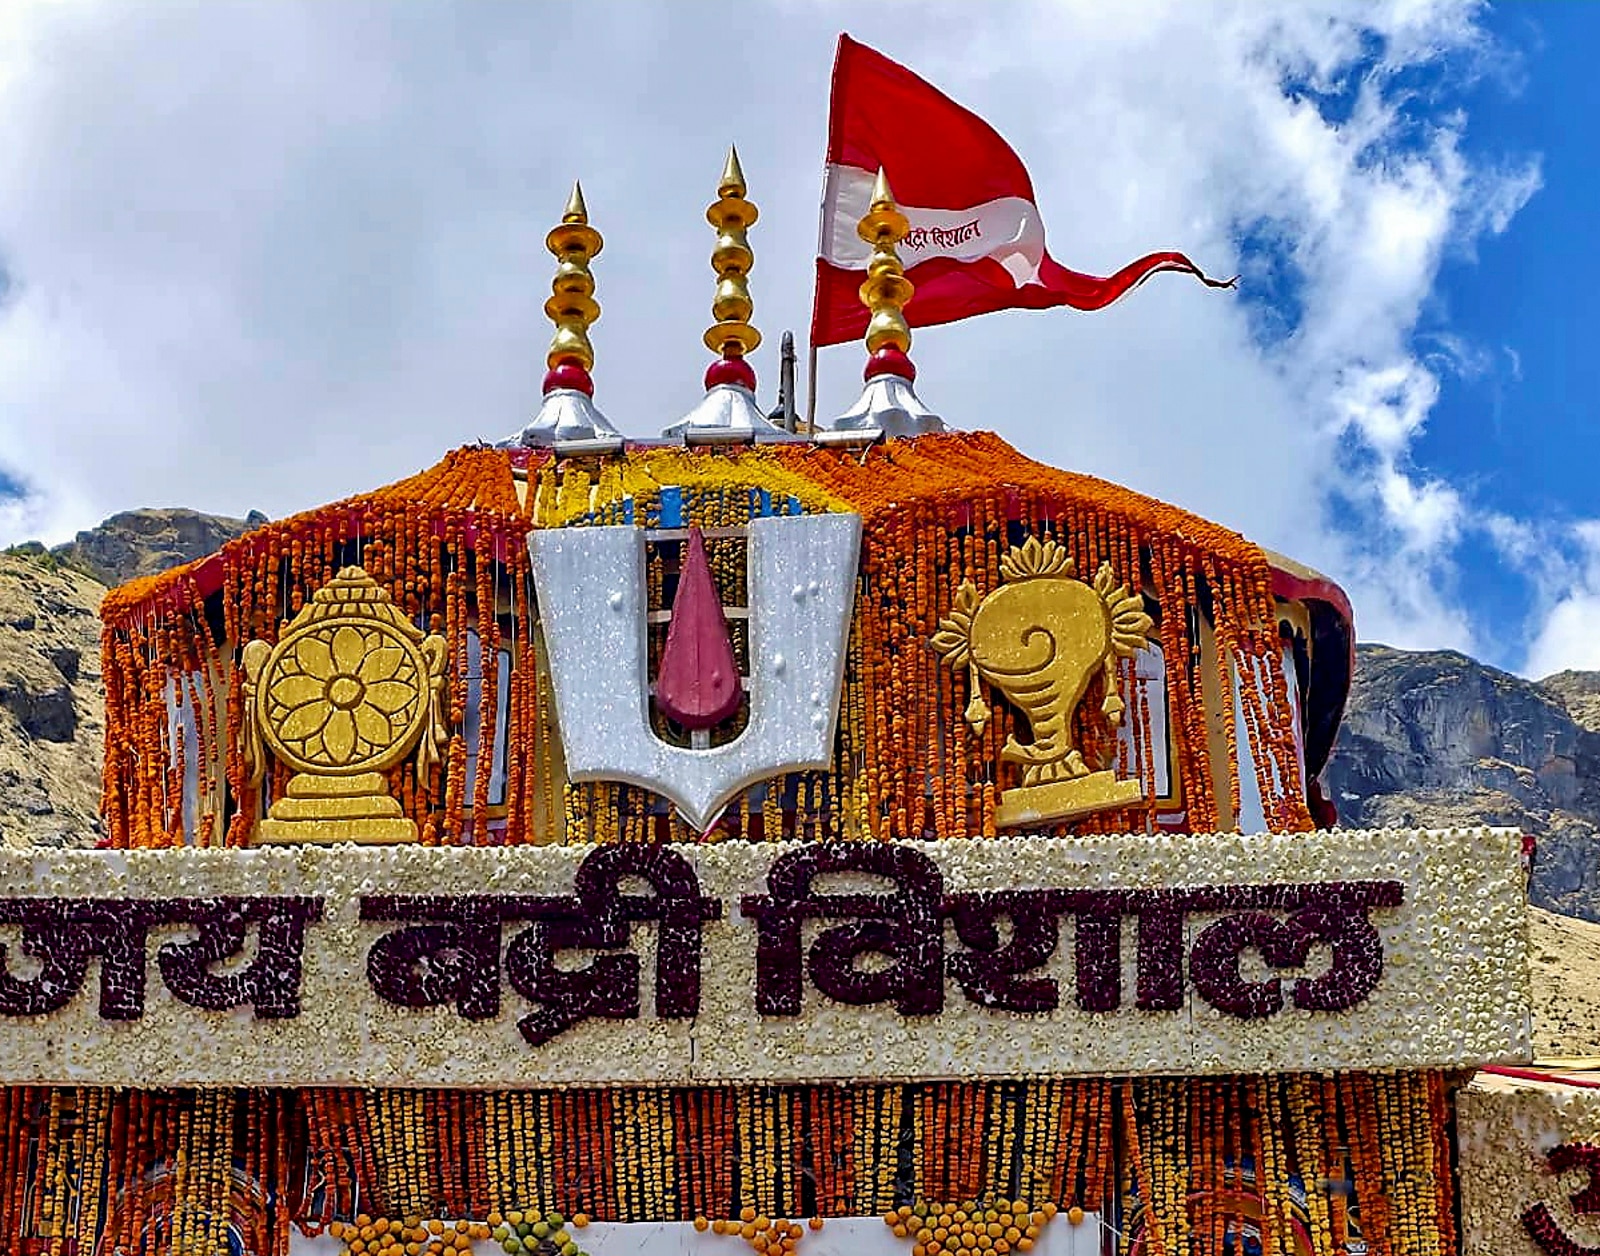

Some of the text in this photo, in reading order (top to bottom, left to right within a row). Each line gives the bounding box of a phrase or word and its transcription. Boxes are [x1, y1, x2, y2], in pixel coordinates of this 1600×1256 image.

[931, 220, 981, 248] विशाल
[358, 841, 723, 1047] बद्री
[741, 839, 1403, 1021] विशाल
